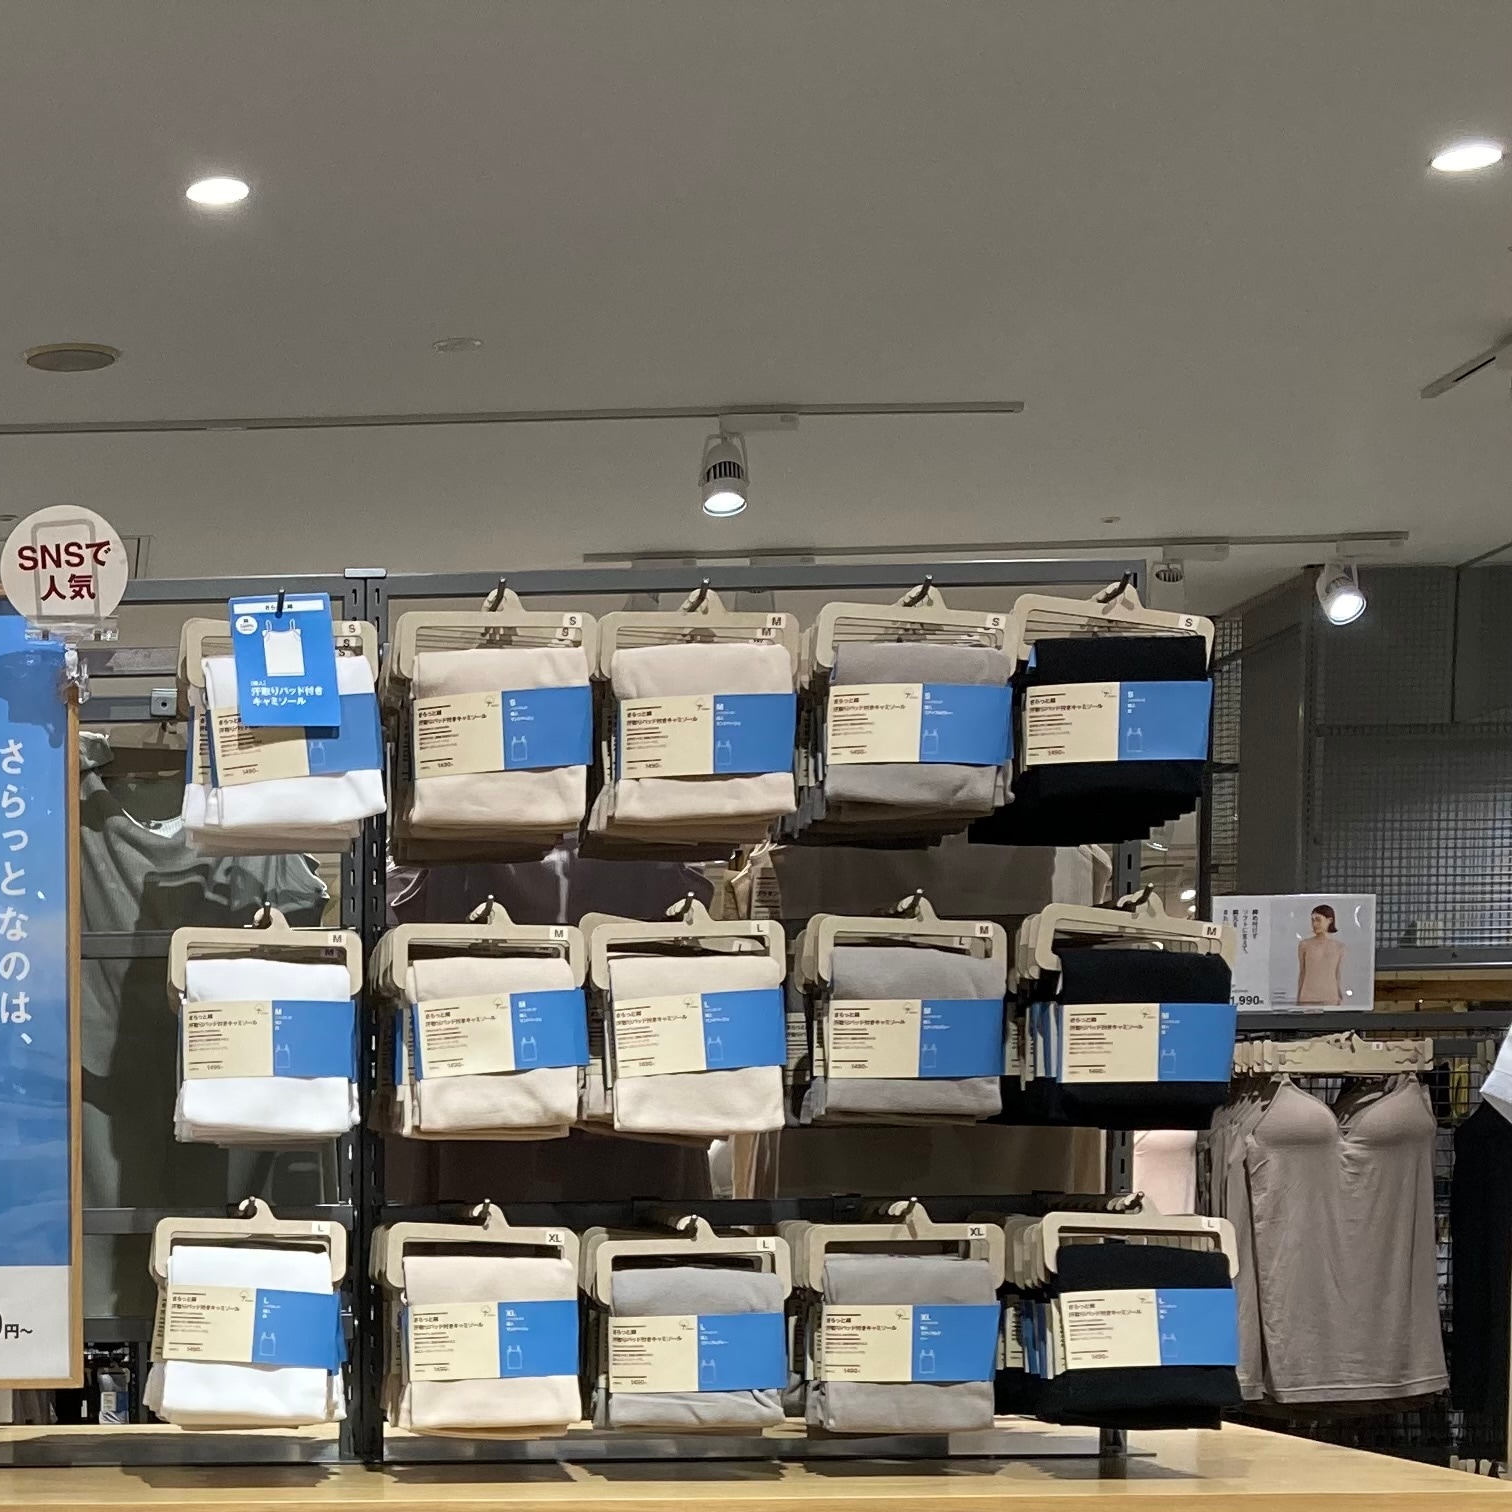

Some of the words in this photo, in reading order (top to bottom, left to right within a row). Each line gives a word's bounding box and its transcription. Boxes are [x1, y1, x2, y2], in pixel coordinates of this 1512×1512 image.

[17, 540, 111, 571] SNSで
[40, 573, 96, 601] 人気
[568, 616, 578, 625] S
[771, 617, 782, 626] M
[992, 617, 1000, 626] S
[1185, 617, 1193, 627] S
[348, 624, 356, 633] S
[562, 628, 569, 636] S
[251, 686, 323, 697] 汗取りパッド付き
[253, 697, 306, 706] キャミソール
[756, 924, 763, 932] L
[979, 926, 989, 934] M
[1207, 927, 1217, 936] M
[554, 929, 564, 938] M
[332, 935, 342, 943] M
[317, 1224, 325, 1232] L
[1206, 1219, 1214, 1228] L
[969, 1227, 985, 1236] XL
[548, 1234, 562, 1243] XL
[762, 1240, 770, 1249] L
